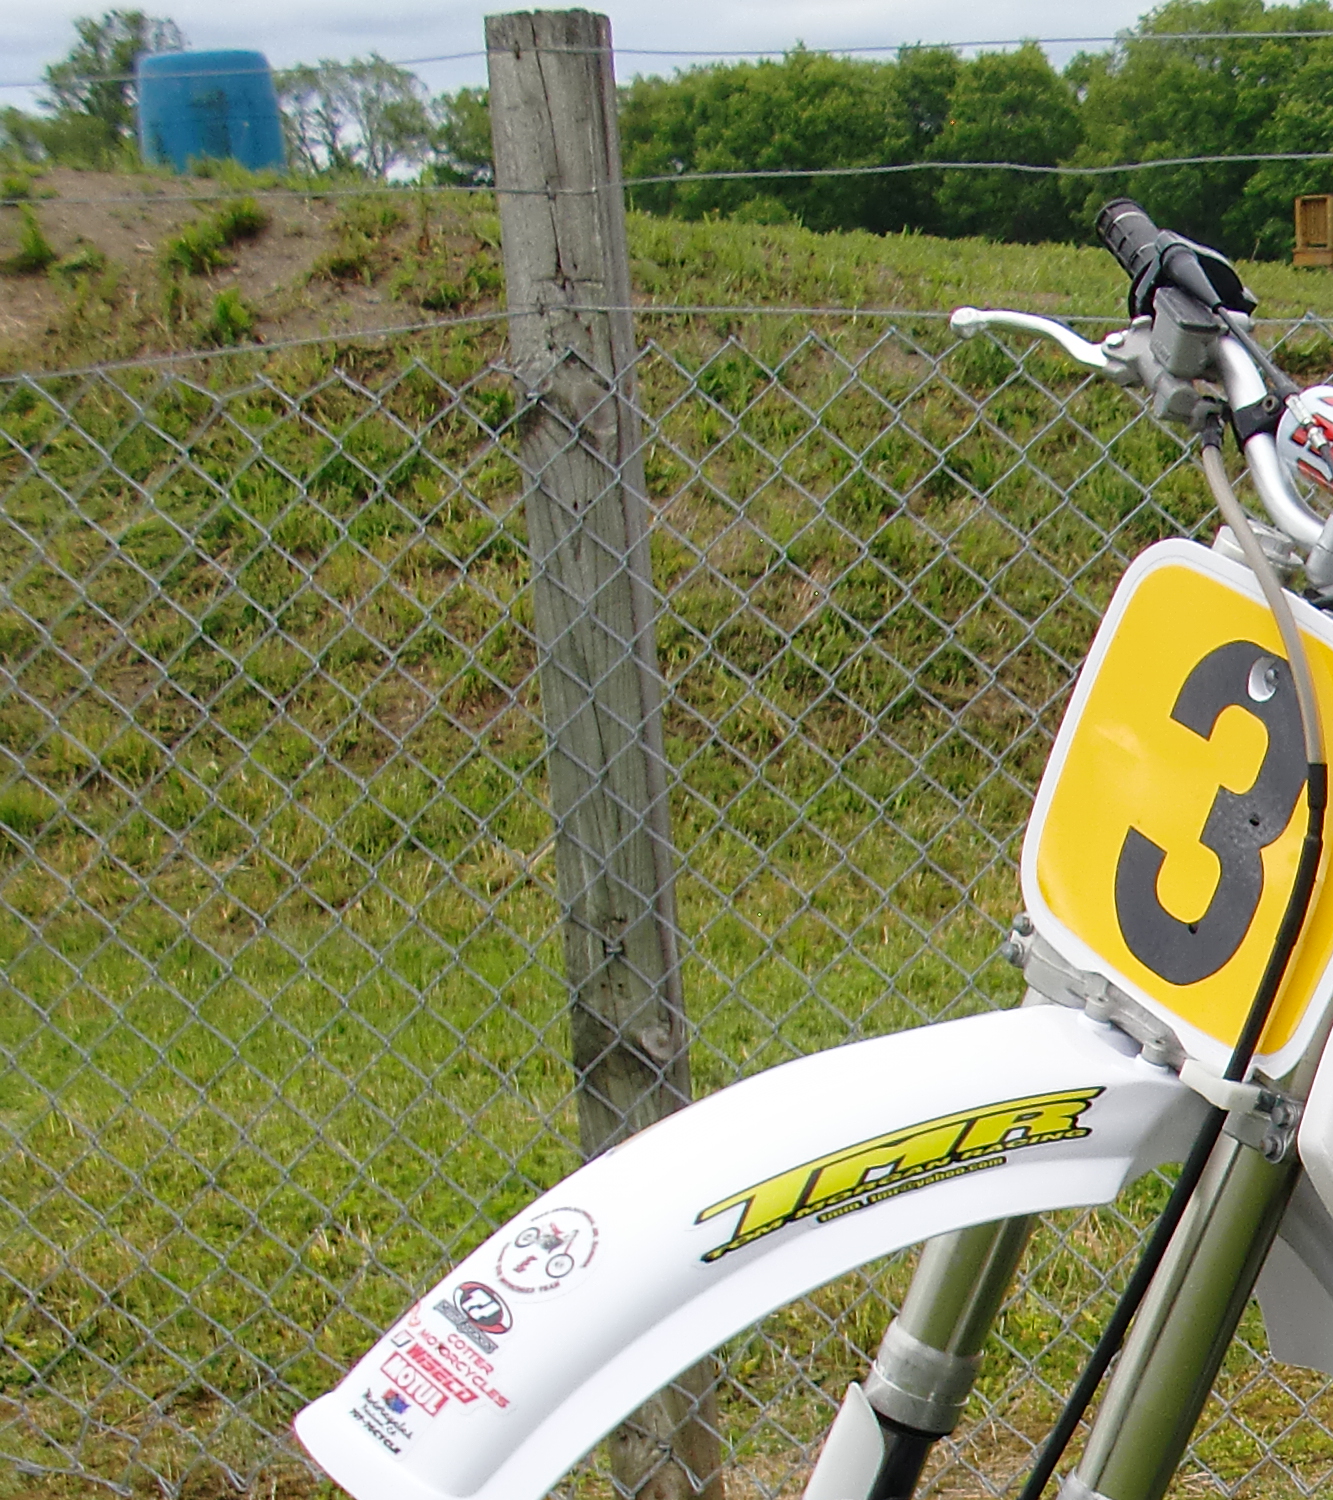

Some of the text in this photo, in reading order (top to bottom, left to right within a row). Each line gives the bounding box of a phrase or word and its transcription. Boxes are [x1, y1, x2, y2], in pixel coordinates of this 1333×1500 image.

[1115, 639, 1309, 986] 3
[694, 1086, 1106, 1235] TMR
[701, 1127, 1092, 1263] TOM MORGAN RACING
[384, 1354, 447, 1416] MOTUL
[448, 1333, 494, 1375] COTTER
